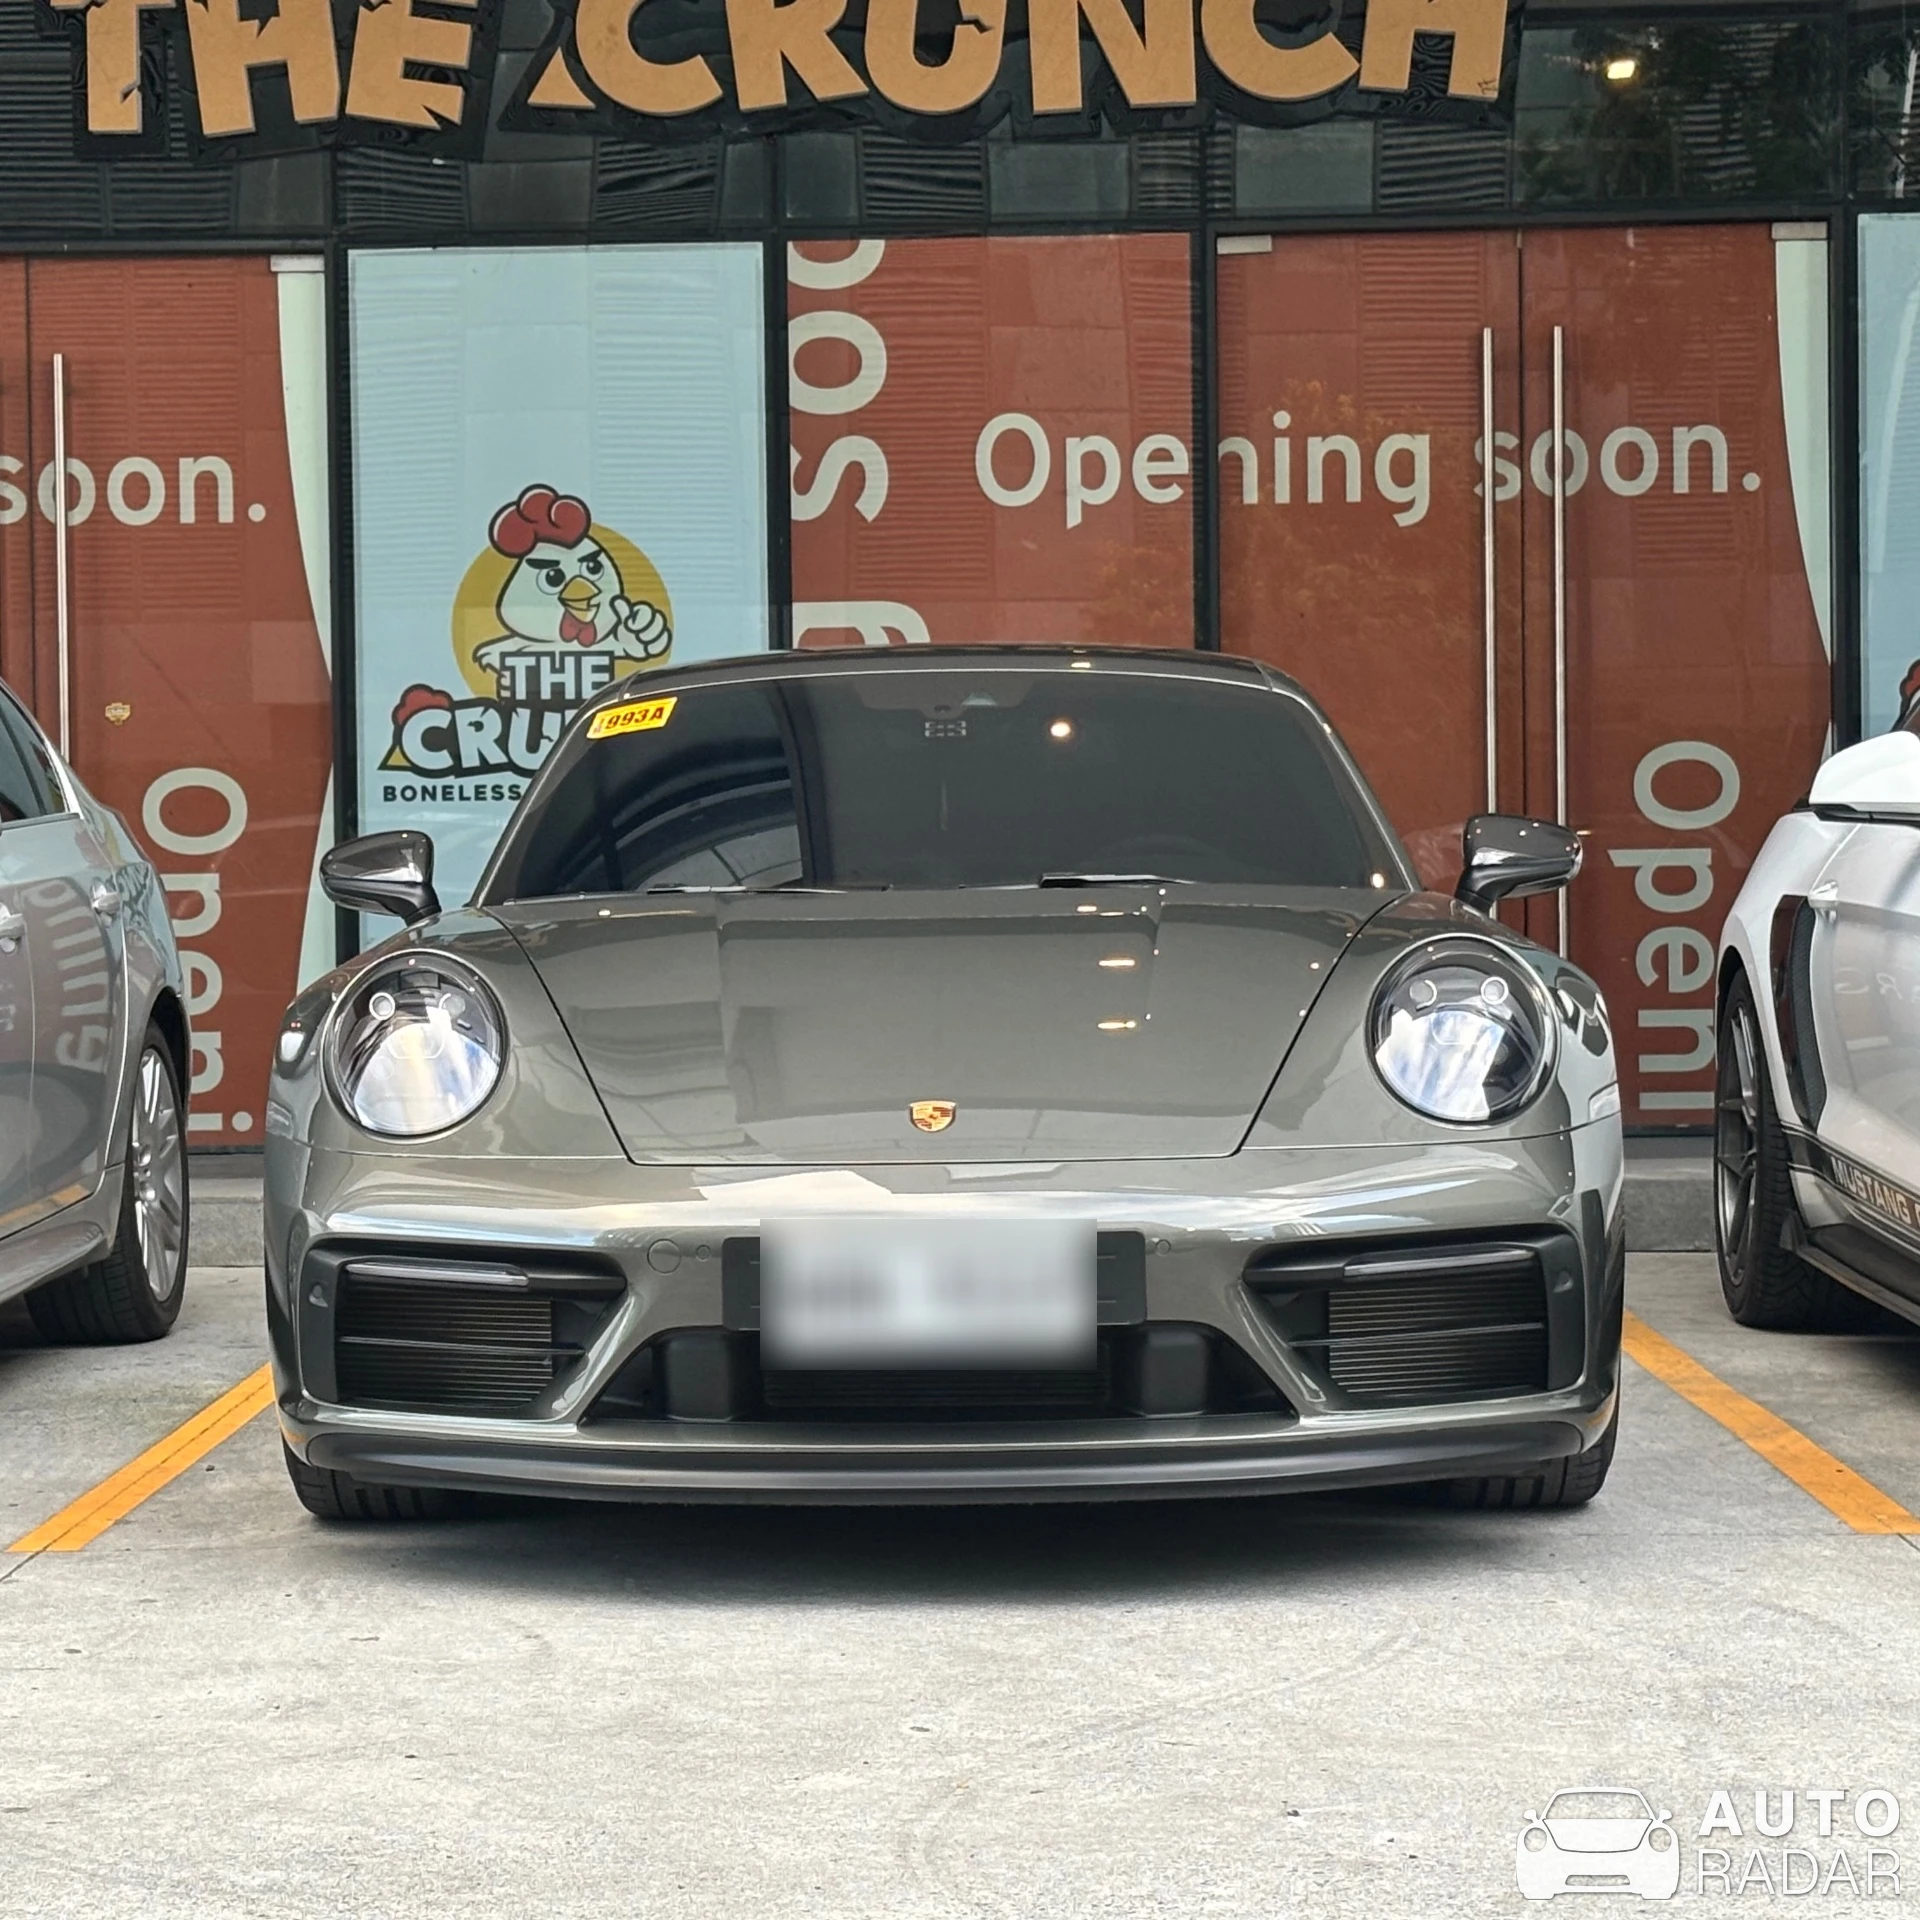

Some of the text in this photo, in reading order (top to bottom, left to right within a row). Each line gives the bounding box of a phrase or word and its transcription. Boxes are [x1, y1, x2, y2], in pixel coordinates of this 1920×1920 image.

[49, 0, 1503, 135] THE CRUNCH
[975, 411, 1762, 530] Opening soon.
[505, 655, 612, 700] THE
[401, 704, 579, 772] CRU
[383, 784, 522, 803] BONELESS
[1830, 1155, 1912, 1225] MUSTANG
